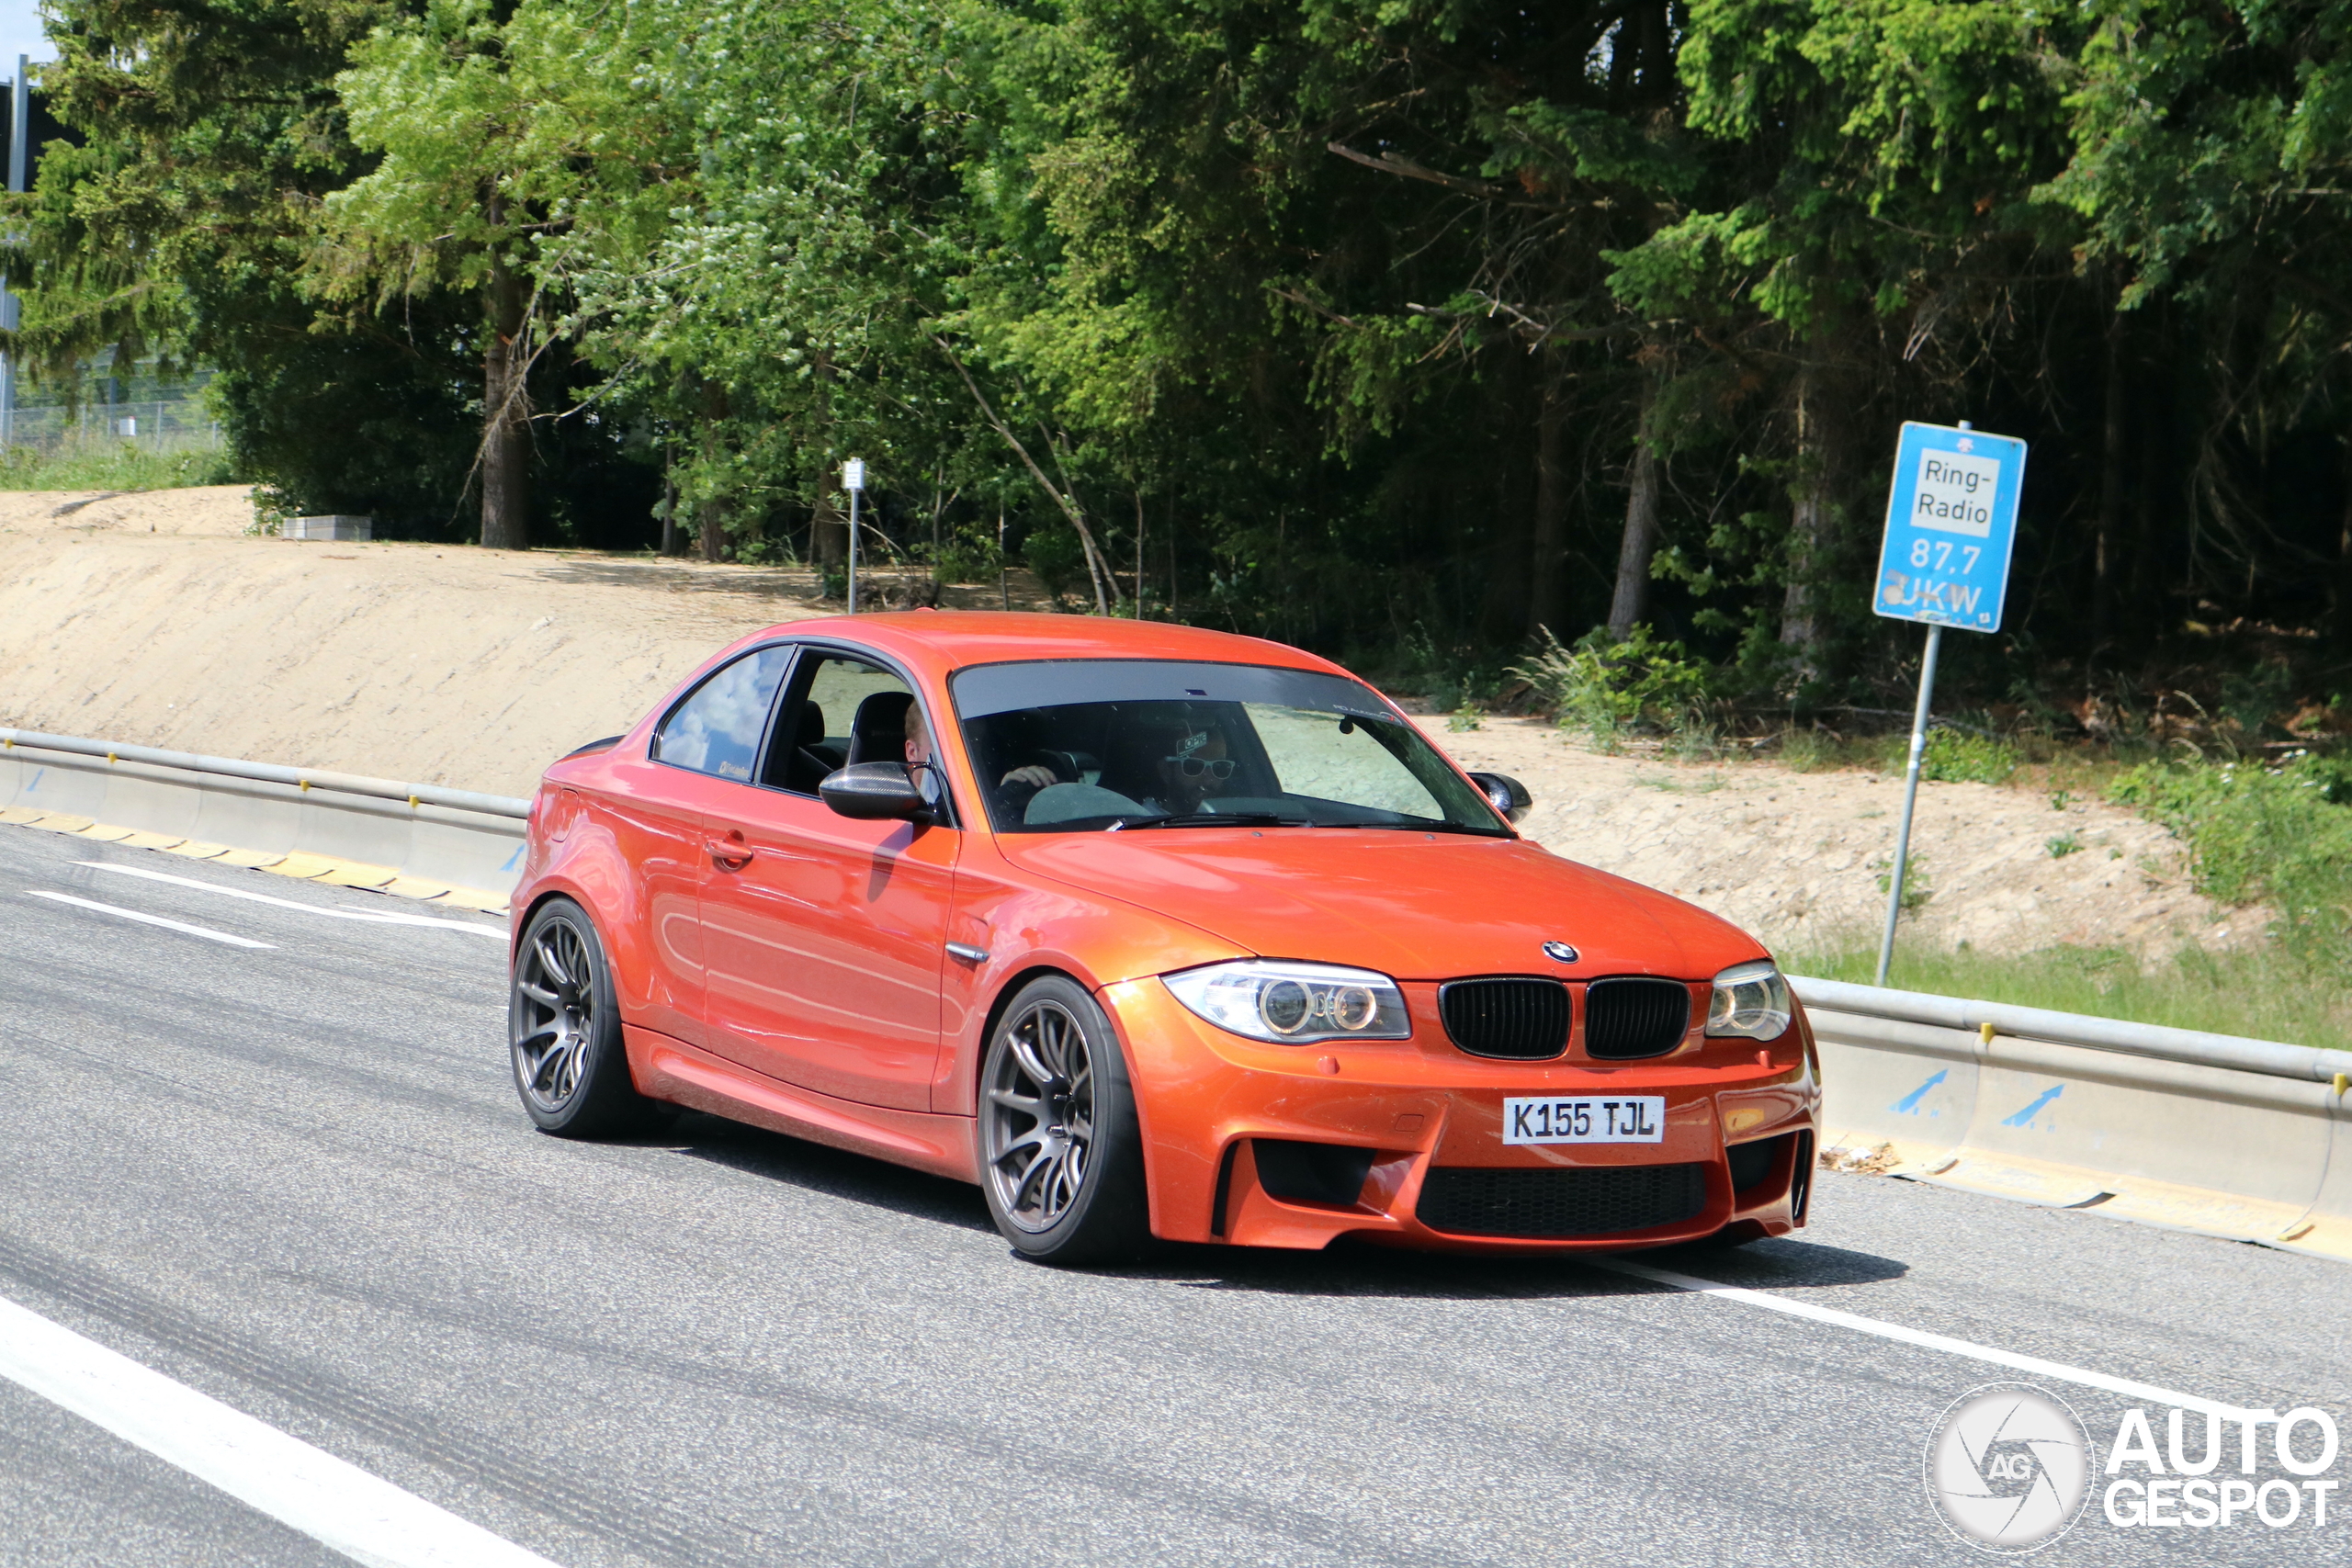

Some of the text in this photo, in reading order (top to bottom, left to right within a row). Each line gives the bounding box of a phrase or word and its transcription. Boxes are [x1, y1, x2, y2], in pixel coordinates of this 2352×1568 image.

[1926, 459, 1992, 493] Ring-
[1917, 493, 1989, 524] Radio
[1514, 1102, 1655, 1137] K155 TJL
